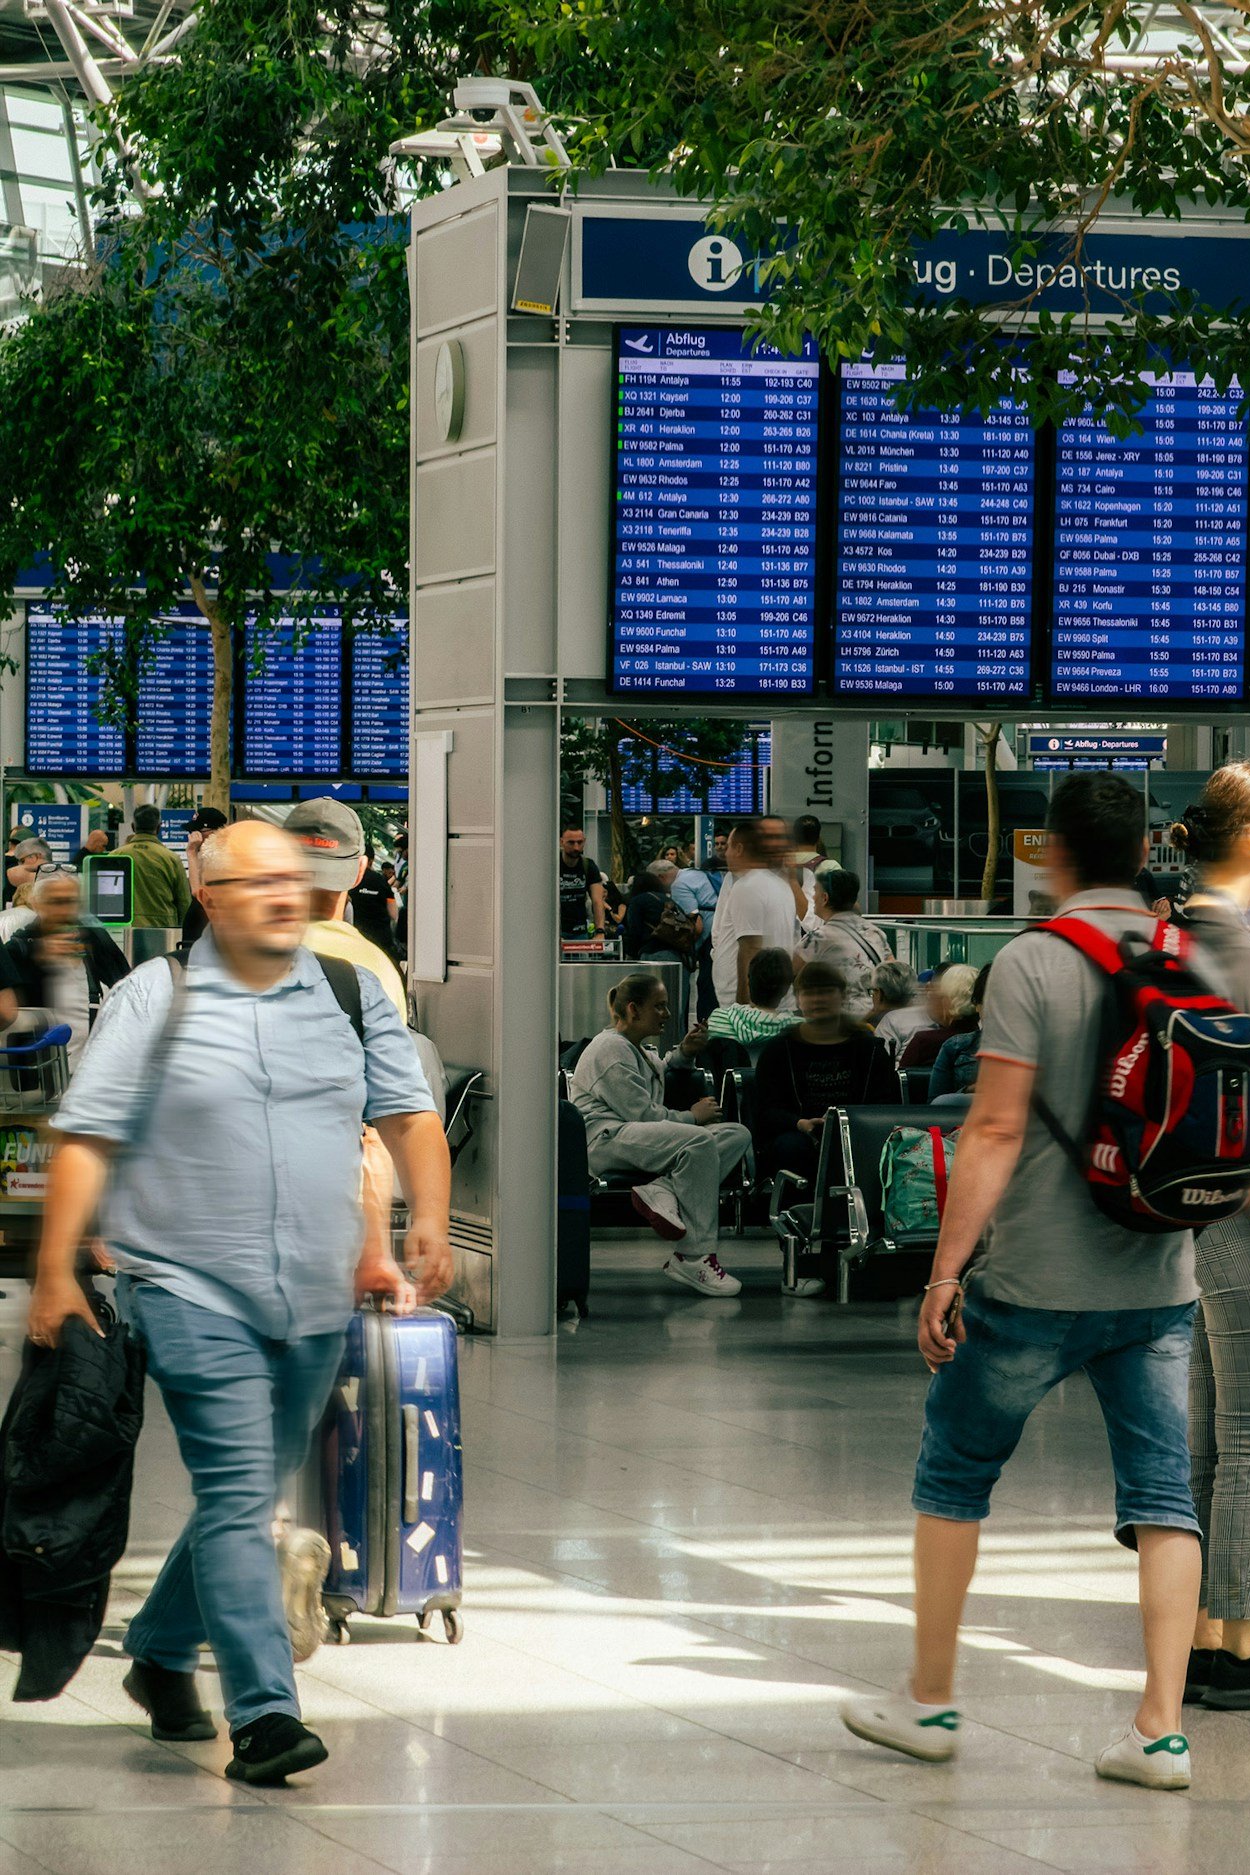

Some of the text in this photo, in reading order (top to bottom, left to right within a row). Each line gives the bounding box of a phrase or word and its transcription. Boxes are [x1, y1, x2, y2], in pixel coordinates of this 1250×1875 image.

[988, 254, 1180, 296] Departures
[666, 333, 705, 347] Abflug
[666, 348, 710, 357] Departures
[804, 343, 810, 355] 1
[625, 375, 812, 388] FH 1194 Antalya 11:55 192-193 C40
[625, 407, 634, 416] BJ
[660, 407, 685, 418] Djerba
[721, 409, 740, 418] 12:00
[796, 411, 810, 420] C31
[855, 463, 871, 471] 8221
[880, 463, 907, 472] Pristina
[940, 464, 958, 473] 13:40
[1014, 466, 1028, 475] C37
[1061, 500, 1071, 509] SK
[1095, 501, 1141, 512] Kopenhagen
[1154, 502, 1172, 511] 15:20
[1196, 503, 1223, 512] 111-120
[1227, 504, 1240, 512] A51
[844, 546, 853, 555] X3
[855, 547, 873, 555] 4572
[878, 547, 892, 556] Kos
[938, 548, 956, 557] 14:20
[621, 576, 632, 585] A3
[657, 577, 679, 586] Athen
[718, 578, 737, 587] 12:50
[1059, 584, 1069, 592] BJ
[1073, 584, 1086, 592] 215
[1093, 584, 1125, 593] Monastir
[1152, 585, 1170, 594] 15:30
[1225, 587, 1239, 595] C54
[1057, 667, 1070, 675] EW
[1091, 667, 1121, 676] Preveza
[1150, 668, 1168, 677] 15:55
[1192, 669, 1219, 677] 151-170
[620, 677, 631, 686] DE
[655, 678, 685, 687] Funchal
[716, 679, 735, 687] 13:25
[759, 679, 788, 688] 181-190
[841, 680, 854, 688] EW
[875, 680, 902, 691] Malaga
[935, 681, 954, 690] 15:00
[977, 682, 1005, 691] 151-170
[1009, 683, 1023, 691] A42
[1075, 741, 1098, 749] Abflug
